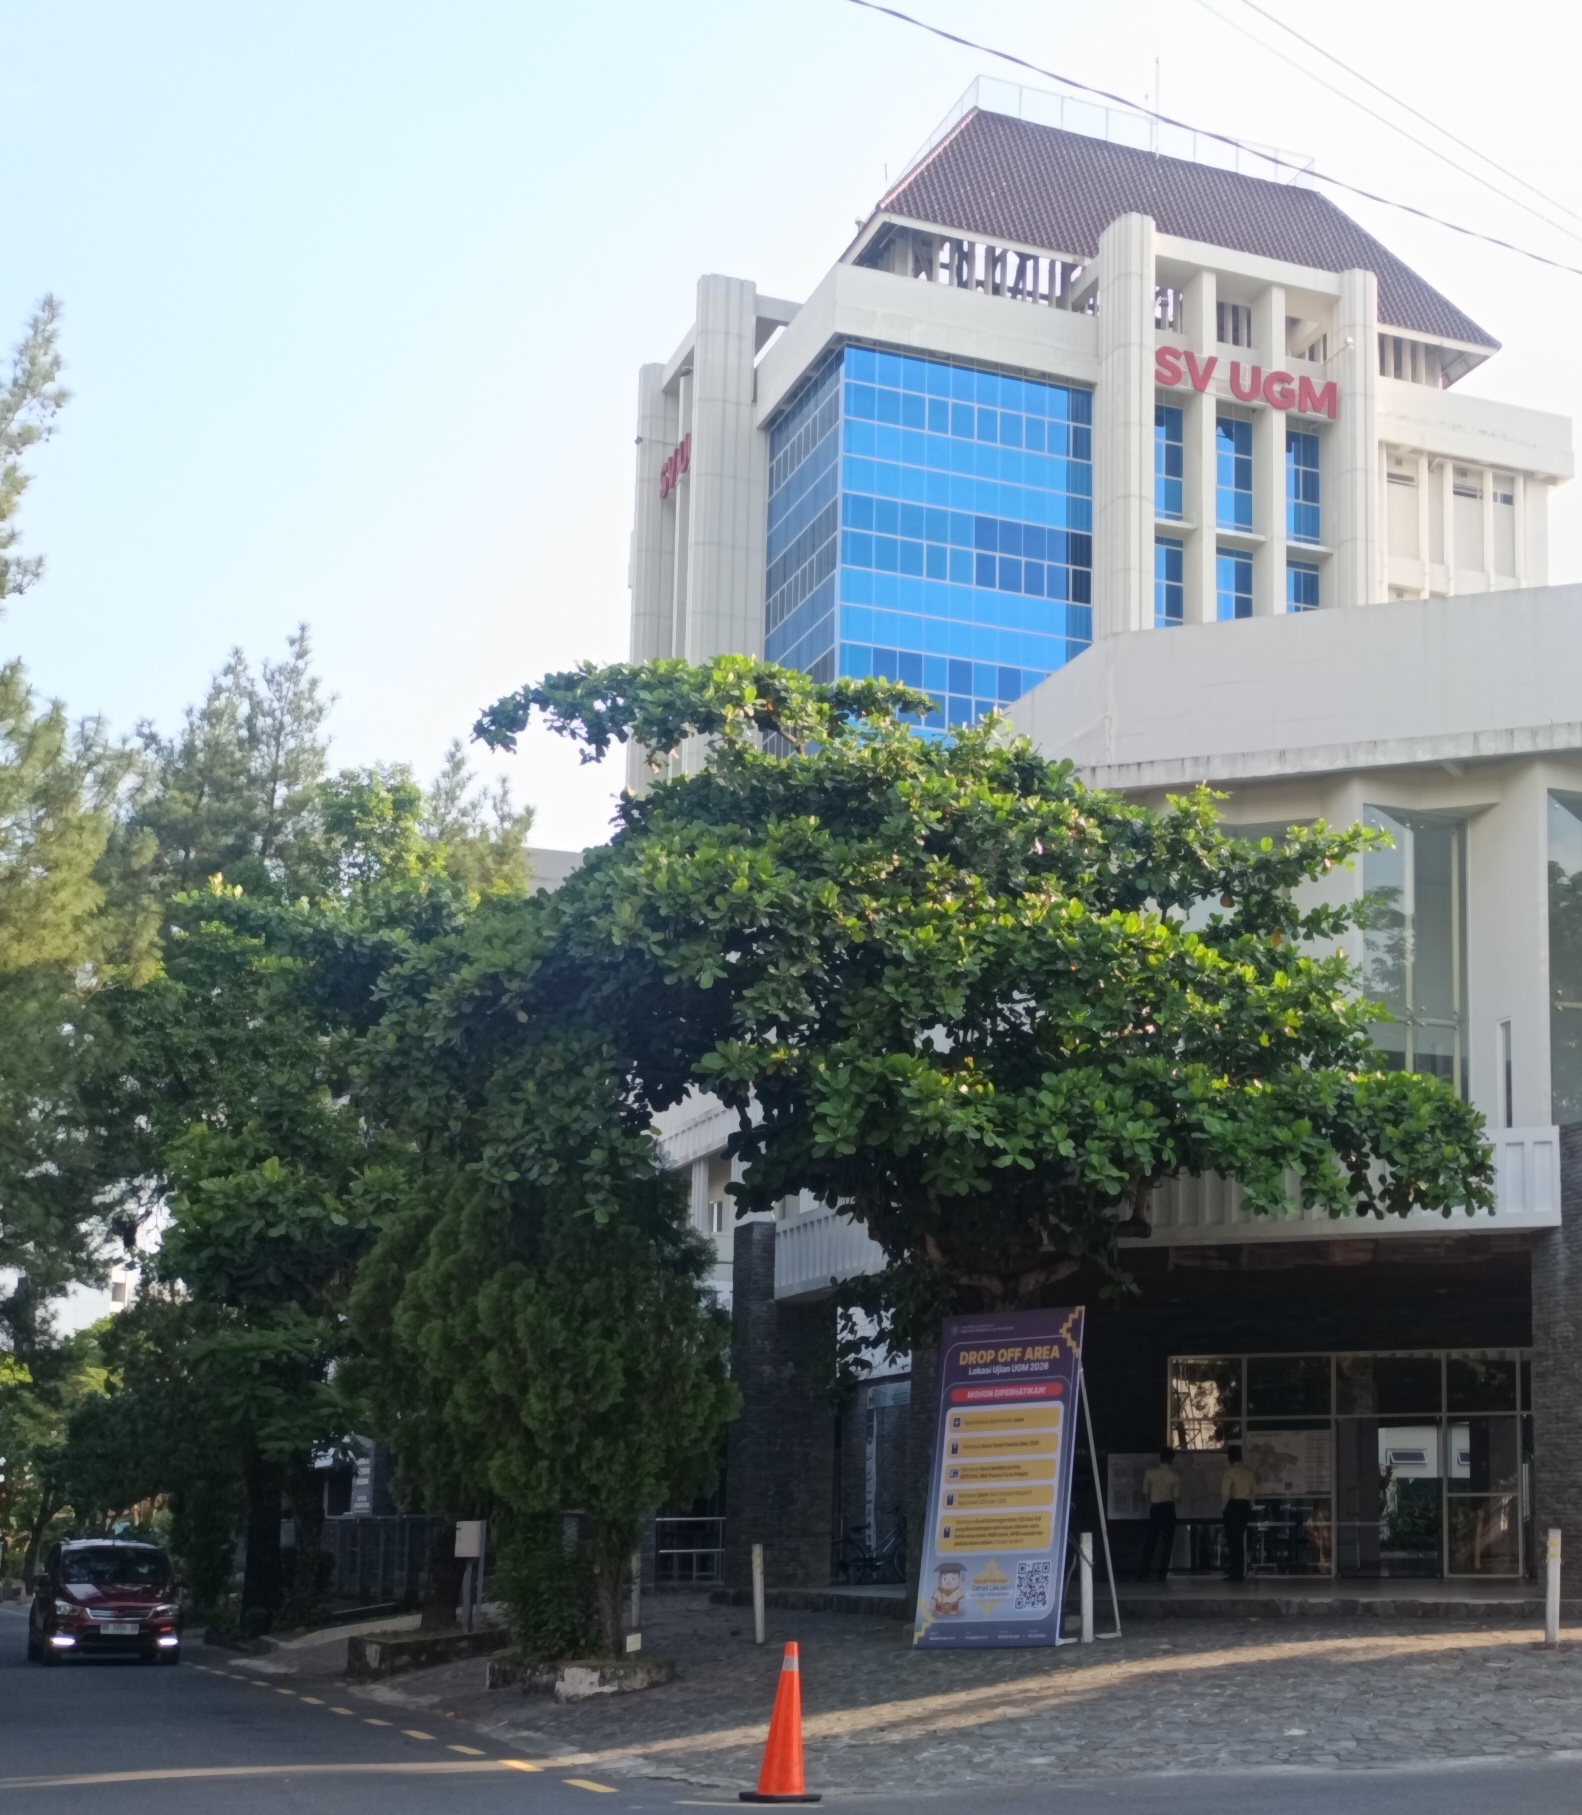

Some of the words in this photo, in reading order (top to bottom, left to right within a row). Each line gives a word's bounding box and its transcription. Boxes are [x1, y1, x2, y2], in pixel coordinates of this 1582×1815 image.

[1154, 345, 1218, 393] SV
[1229, 360, 1338, 420] UGM
[959, 1350, 996, 1366] DROP
[997, 1347, 1023, 1363] OFF
[1024, 1344, 1060, 1361] AREA
[968, 1366, 992, 1376] Lokasi
[992, 1364, 1011, 1376] Ujian
[1011, 1363, 1029, 1373] UGM
[1029, 1361, 1050, 1371] 2026
[967, 1388, 994, 1399] MOHON
[994, 1386, 1046, 1398] DIPERHATIKAN!
